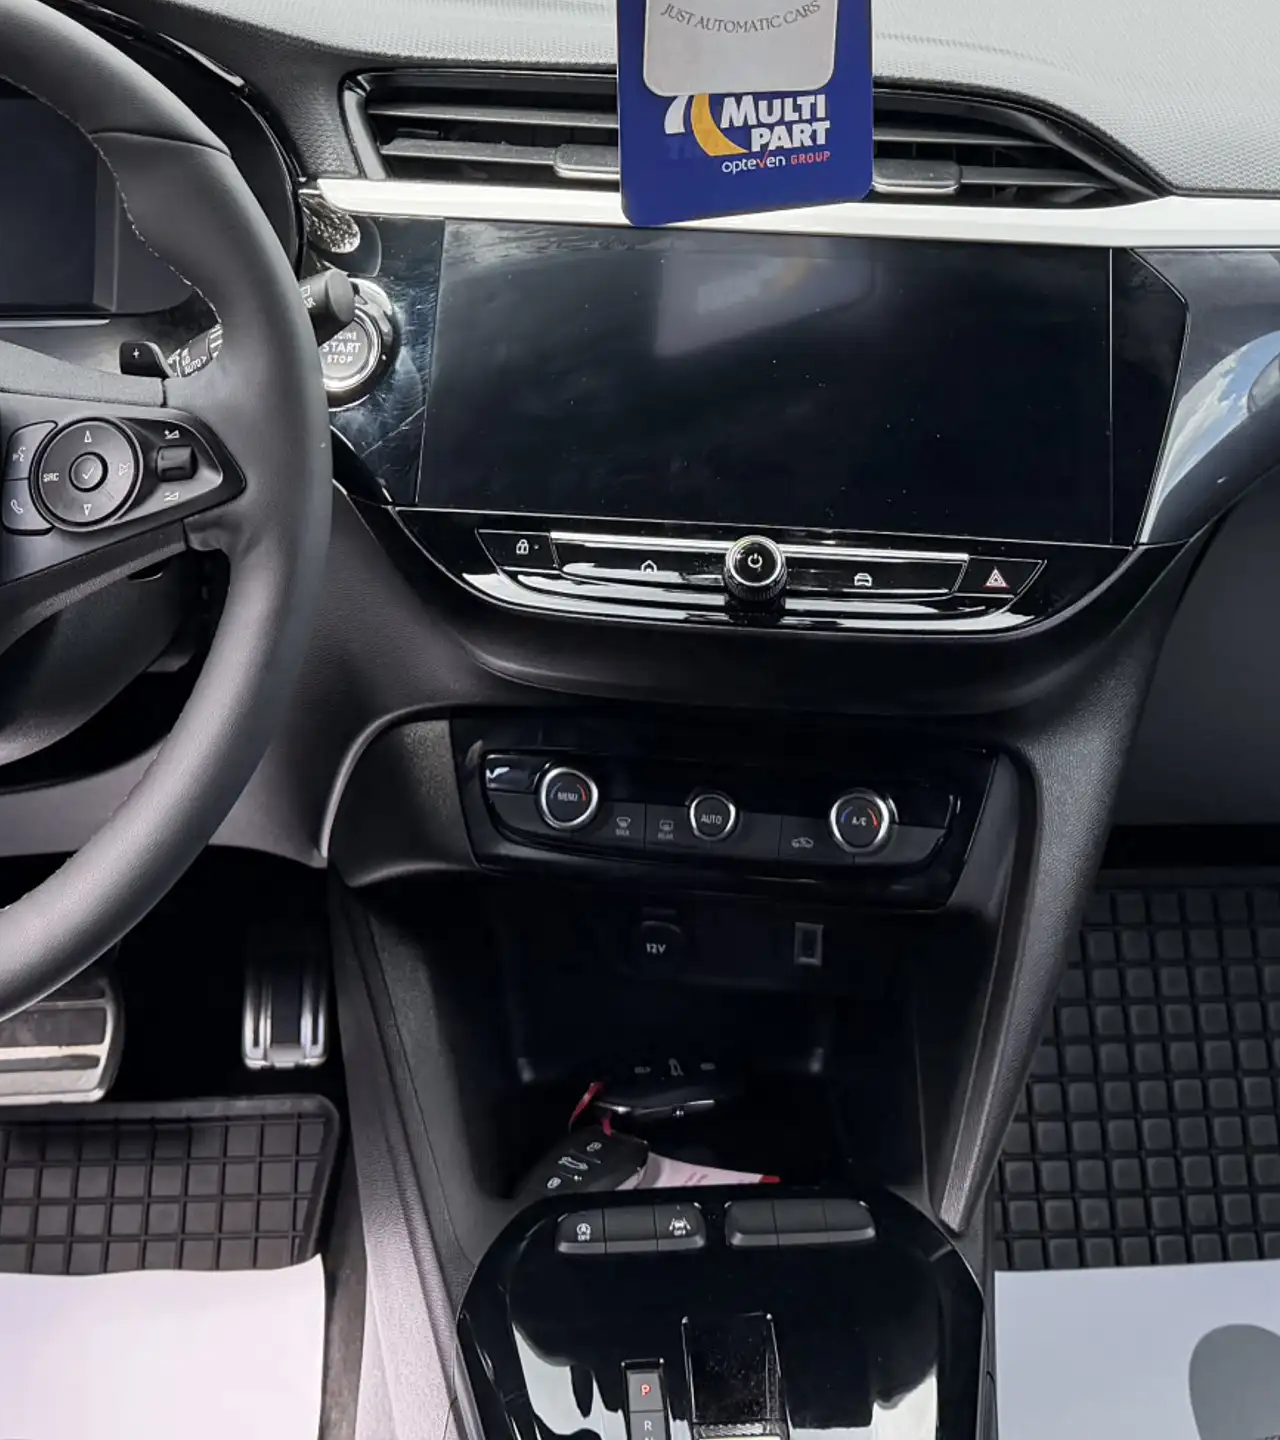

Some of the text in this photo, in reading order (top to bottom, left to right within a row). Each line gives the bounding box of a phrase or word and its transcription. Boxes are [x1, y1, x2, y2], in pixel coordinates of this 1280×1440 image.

[660, 0, 821, 34] JUST AUTOMATIC CARS
[720, 94, 826, 128] MULTI
[751, 121, 830, 152] PART
[721, 151, 831, 175] opteven GROUP
[322, 342, 361, 353] START
[327, 355, 353, 364] STOP
[43, 472, 60, 482] SRC
[557, 791, 578, 802] MENU
[701, 814, 722, 824] AUTO
[646, 943, 666, 954] 12V
[641, 1383, 651, 1396] P
[644, 1420, 652, 1431] R
